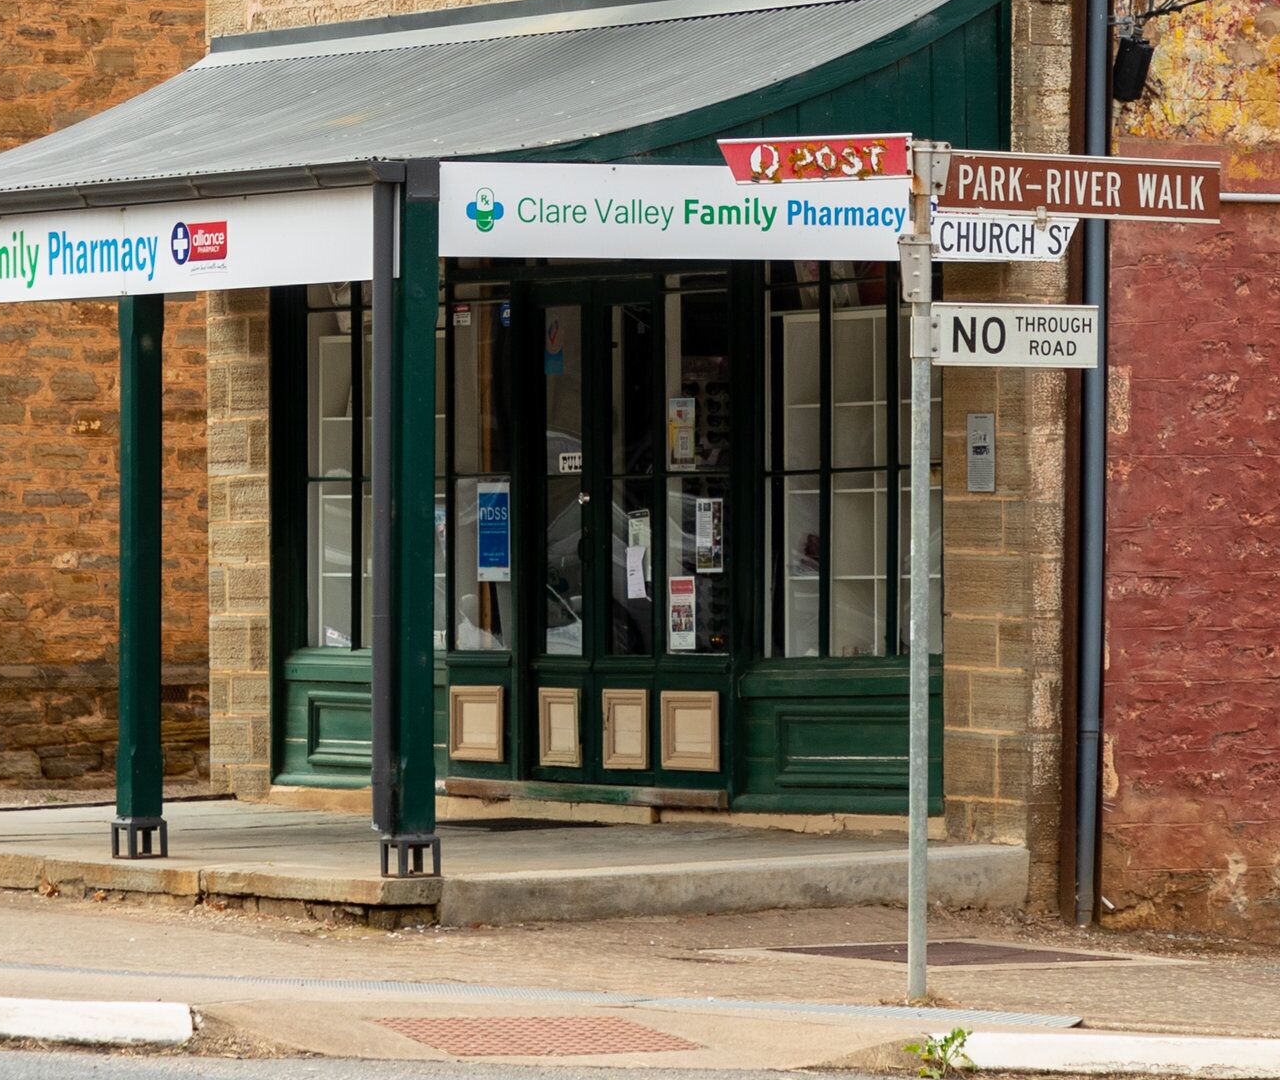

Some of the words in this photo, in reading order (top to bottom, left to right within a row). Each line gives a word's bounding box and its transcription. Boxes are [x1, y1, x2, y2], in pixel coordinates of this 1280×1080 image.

[1138, 173, 1205, 210] WALK
[517, 197, 587, 224] Clare
[594, 198, 675, 231] Valley
[684, 198, 778, 232] Family
[787, 200, 906, 233] Pharmacy
[192, 229, 225, 247] alliance
[939, 220, 1035, 255] CHURCH
[48, 231, 158, 282] Pharmacy
[952, 316, 1006, 355] NO
[1015, 316, 1093, 334] THROUGH
[1029, 340, 1077, 357] ROAD
